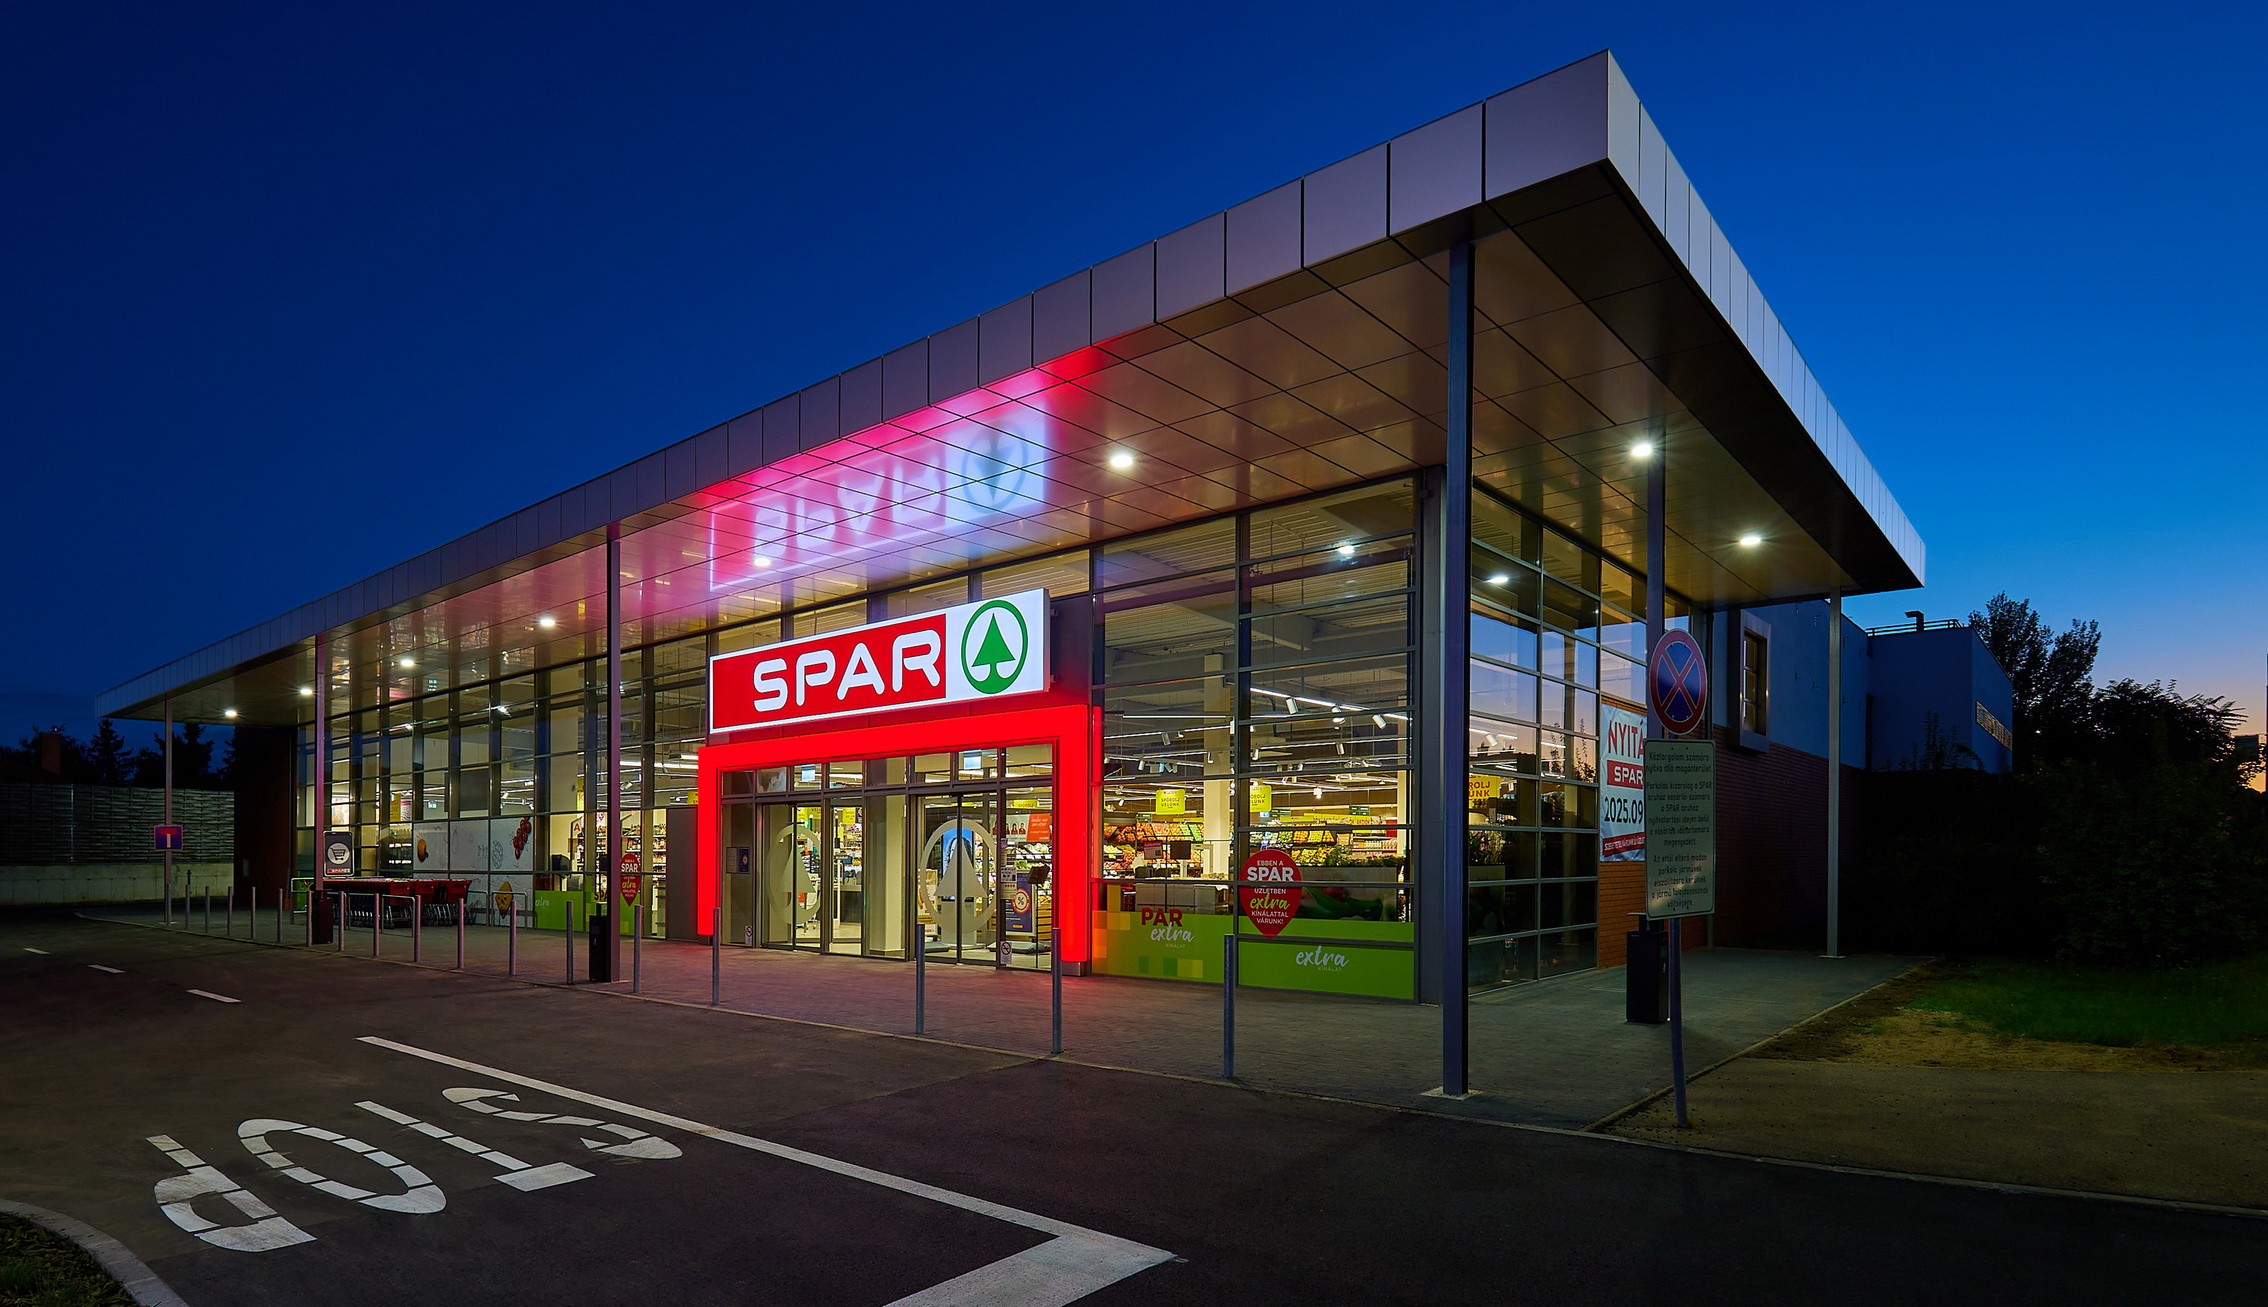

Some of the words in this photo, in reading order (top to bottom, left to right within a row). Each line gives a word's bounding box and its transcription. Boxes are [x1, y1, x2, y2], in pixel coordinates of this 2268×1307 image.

[753, 629, 941, 712] SPAR
[1614, 766, 1643, 784] SPAR
[1699, 781, 1712, 790] SPAR
[1666, 803, 1680, 812] SPAR
[621, 863, 638, 872] SPAR
[1247, 867, 1294, 881] SPAR
[1249, 893, 1291, 910] extra
[1141, 907, 1183, 927] PAR
[1251, 909, 1289, 918] KÍNÁLATTAL
[1256, 917, 1284, 925] VÁRUNK!
[1150, 921, 1195, 942] extra
[1295, 944, 1350, 967] extra
[146, 1086, 684, 1253] STOP
